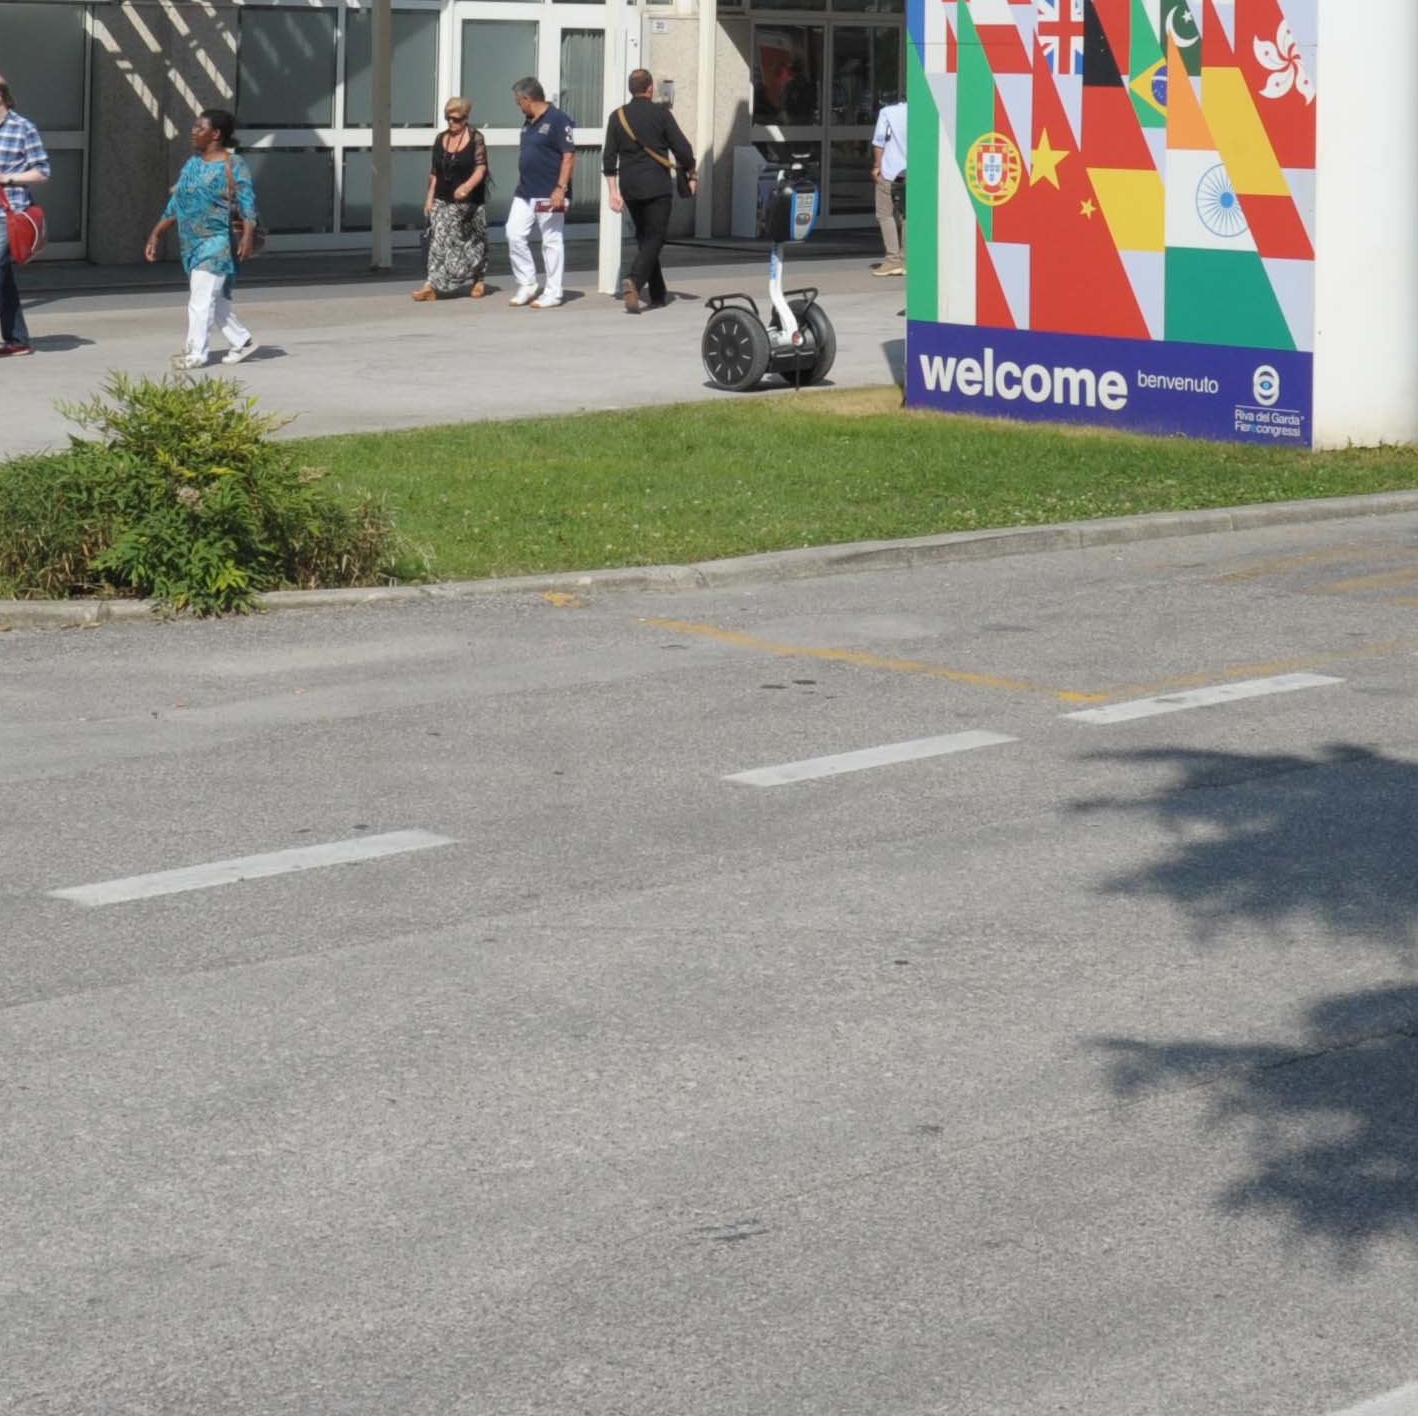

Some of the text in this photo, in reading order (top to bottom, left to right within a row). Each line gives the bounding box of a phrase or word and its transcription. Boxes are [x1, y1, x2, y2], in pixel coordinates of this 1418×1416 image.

[920, 348, 1128, 410] welcome
[1137, 369, 1219, 394] benvenuto
[1235, 409, 1300, 425] Riva del Garda
